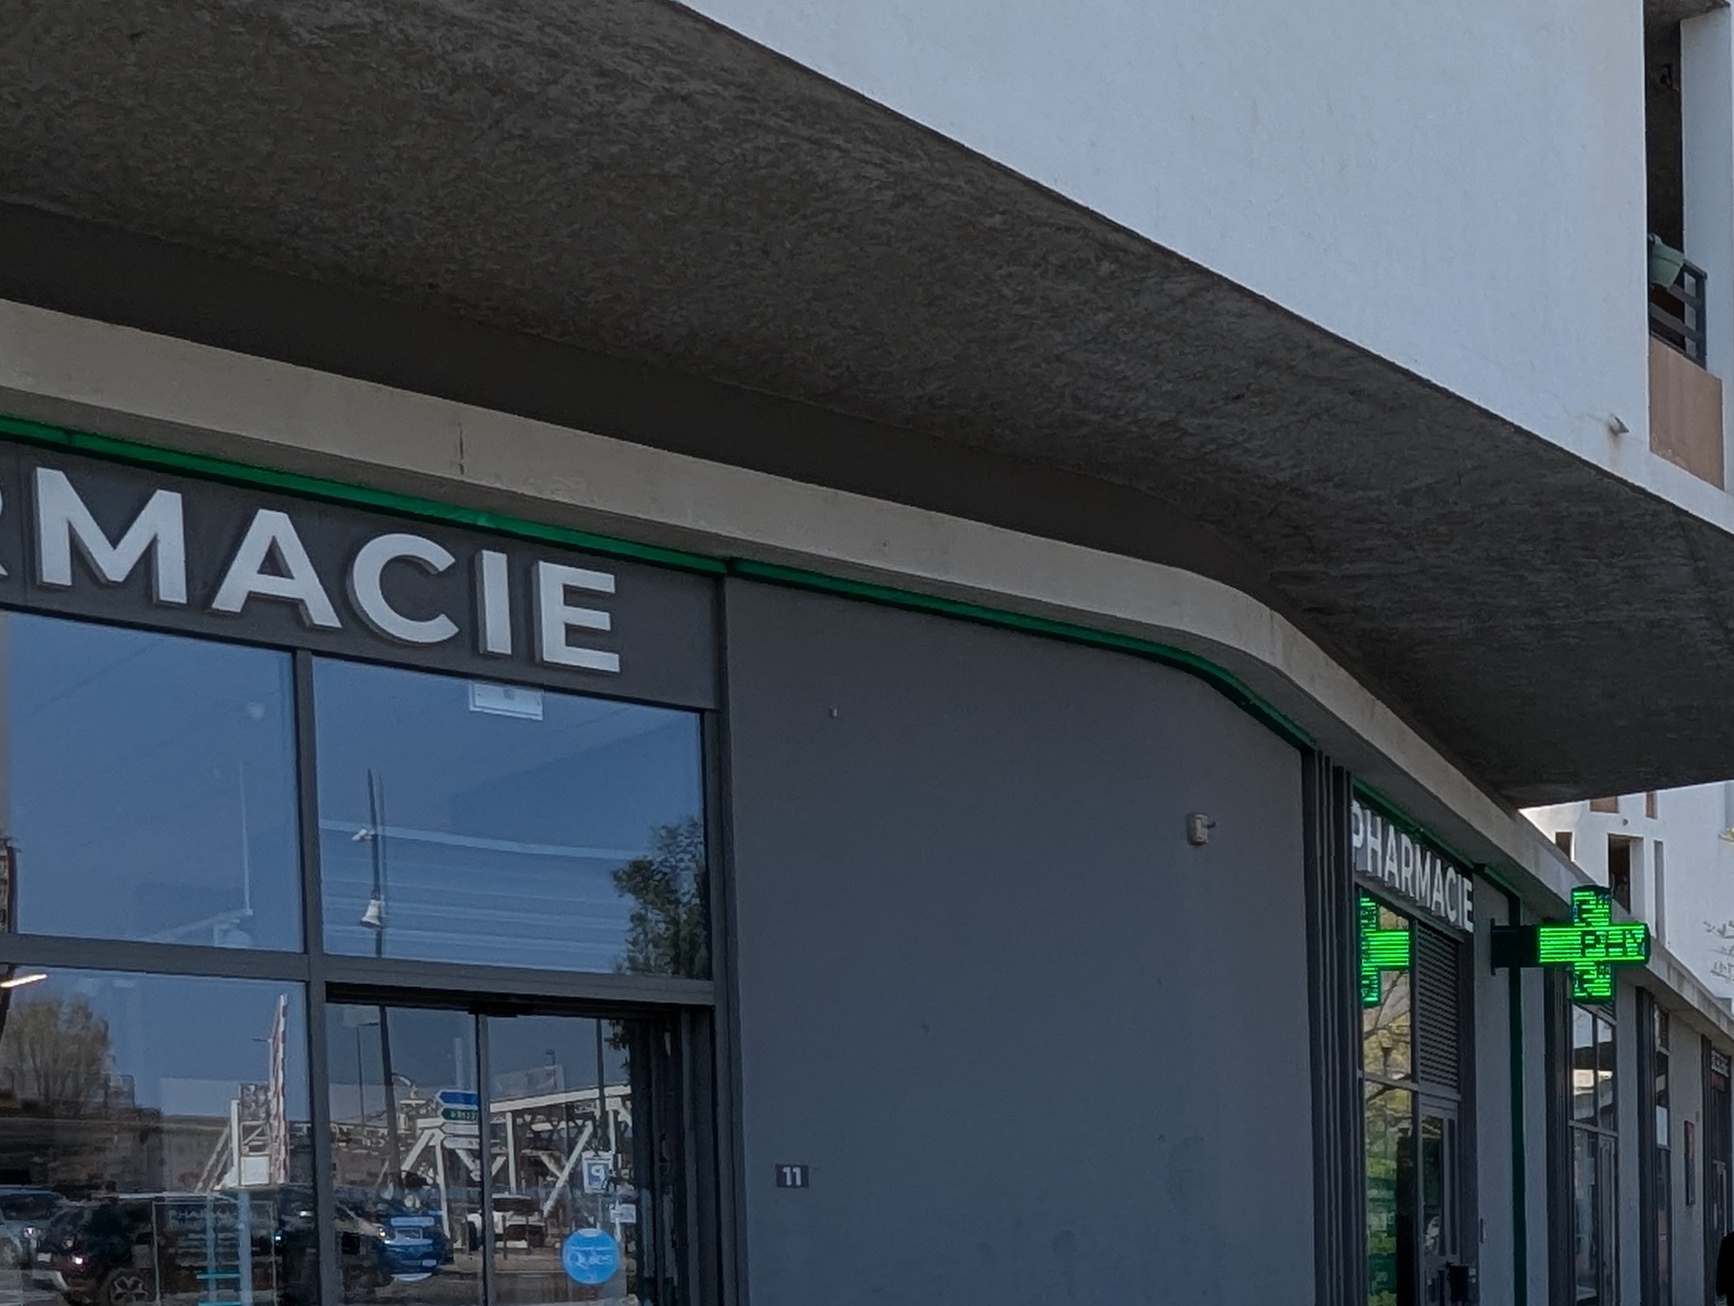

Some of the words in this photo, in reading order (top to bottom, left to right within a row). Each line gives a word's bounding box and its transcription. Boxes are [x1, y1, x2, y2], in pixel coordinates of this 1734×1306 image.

[0, 466, 621, 673] MACIE
[1351, 799, 1474, 933] PHARMACIE
[783, 1166, 802, 1186] 11
